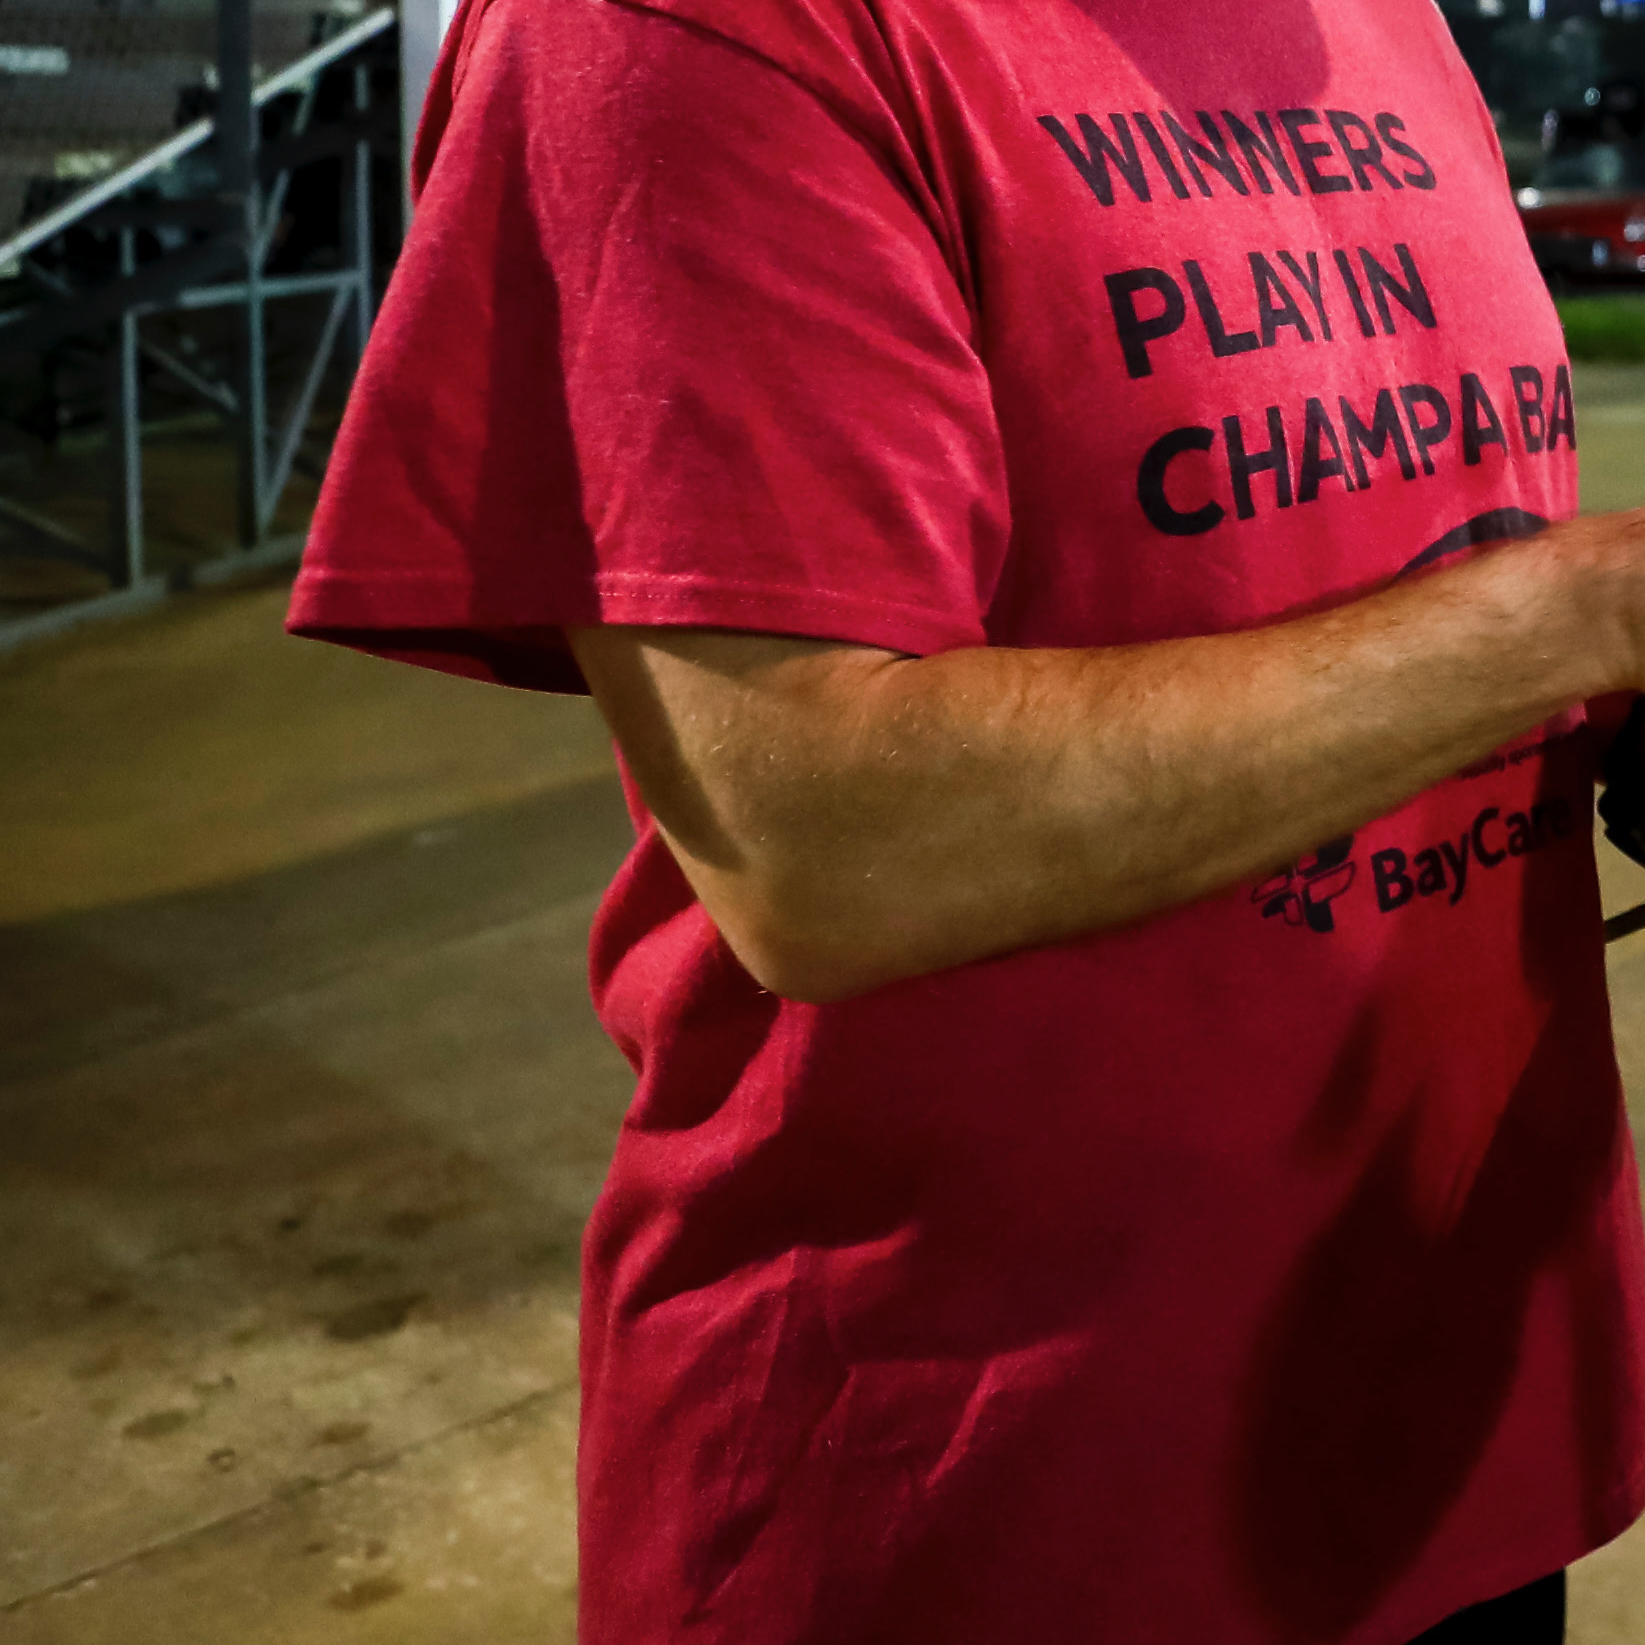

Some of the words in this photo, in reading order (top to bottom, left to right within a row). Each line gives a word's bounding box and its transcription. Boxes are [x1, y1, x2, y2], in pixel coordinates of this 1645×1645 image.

[1037, 107, 1437, 207] WINNERS
[1103, 249, 1332, 379] PLAY
[1334, 243, 1437, 338] IN
[1136, 372, 1508, 537] CHAMPA
[1508, 364, 1578, 454] BA
[1370, 795, 1575, 914] BayCare
